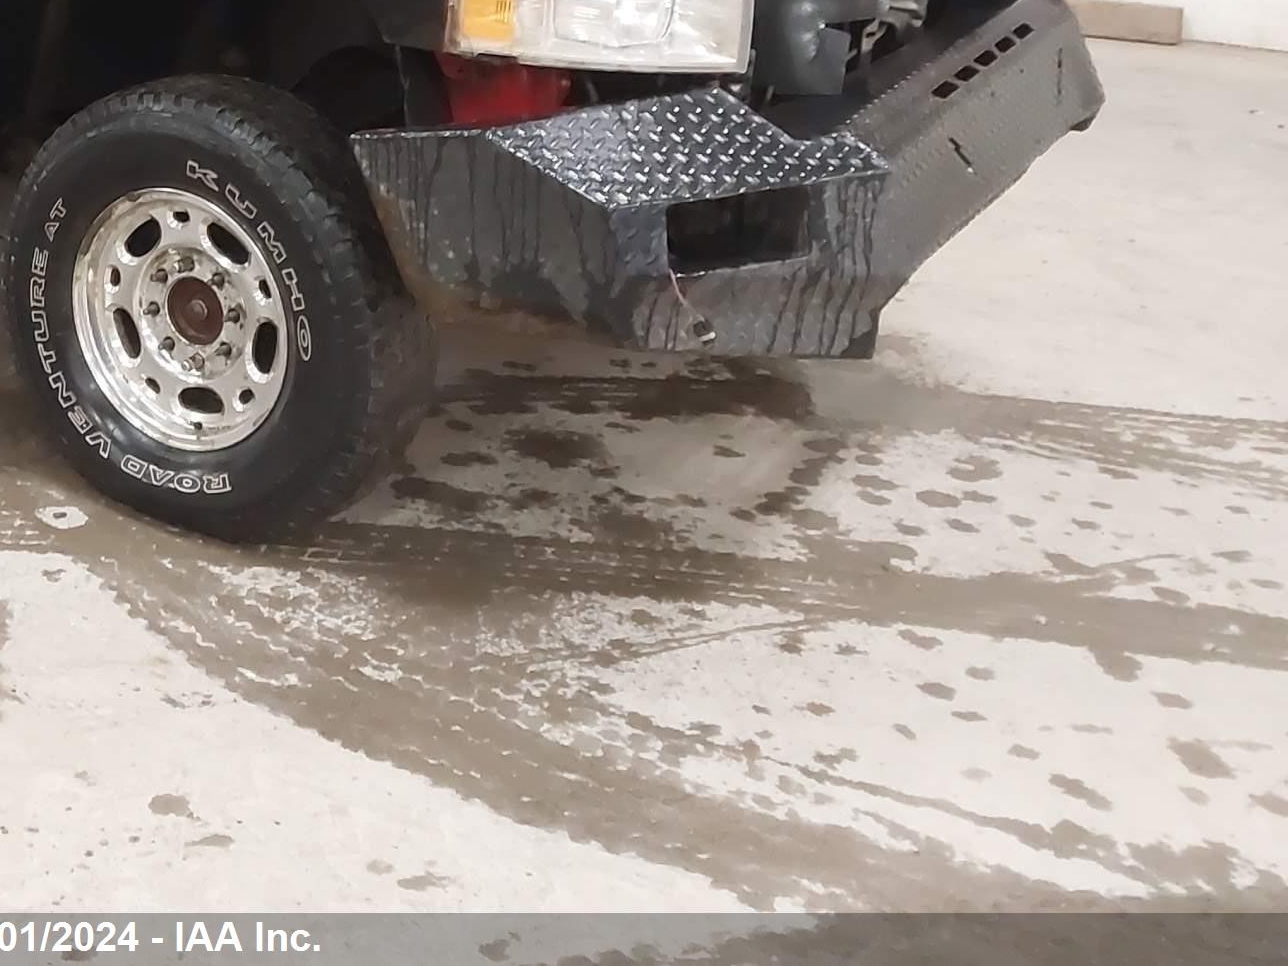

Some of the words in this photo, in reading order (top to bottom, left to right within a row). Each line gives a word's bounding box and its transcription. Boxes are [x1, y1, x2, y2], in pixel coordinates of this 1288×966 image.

[45, 197, 68, 242] AT
[186, 160, 312, 362] KUMHO
[28, 246, 112, 460] VENTURE
[120, 453, 233, 495] ROAD
